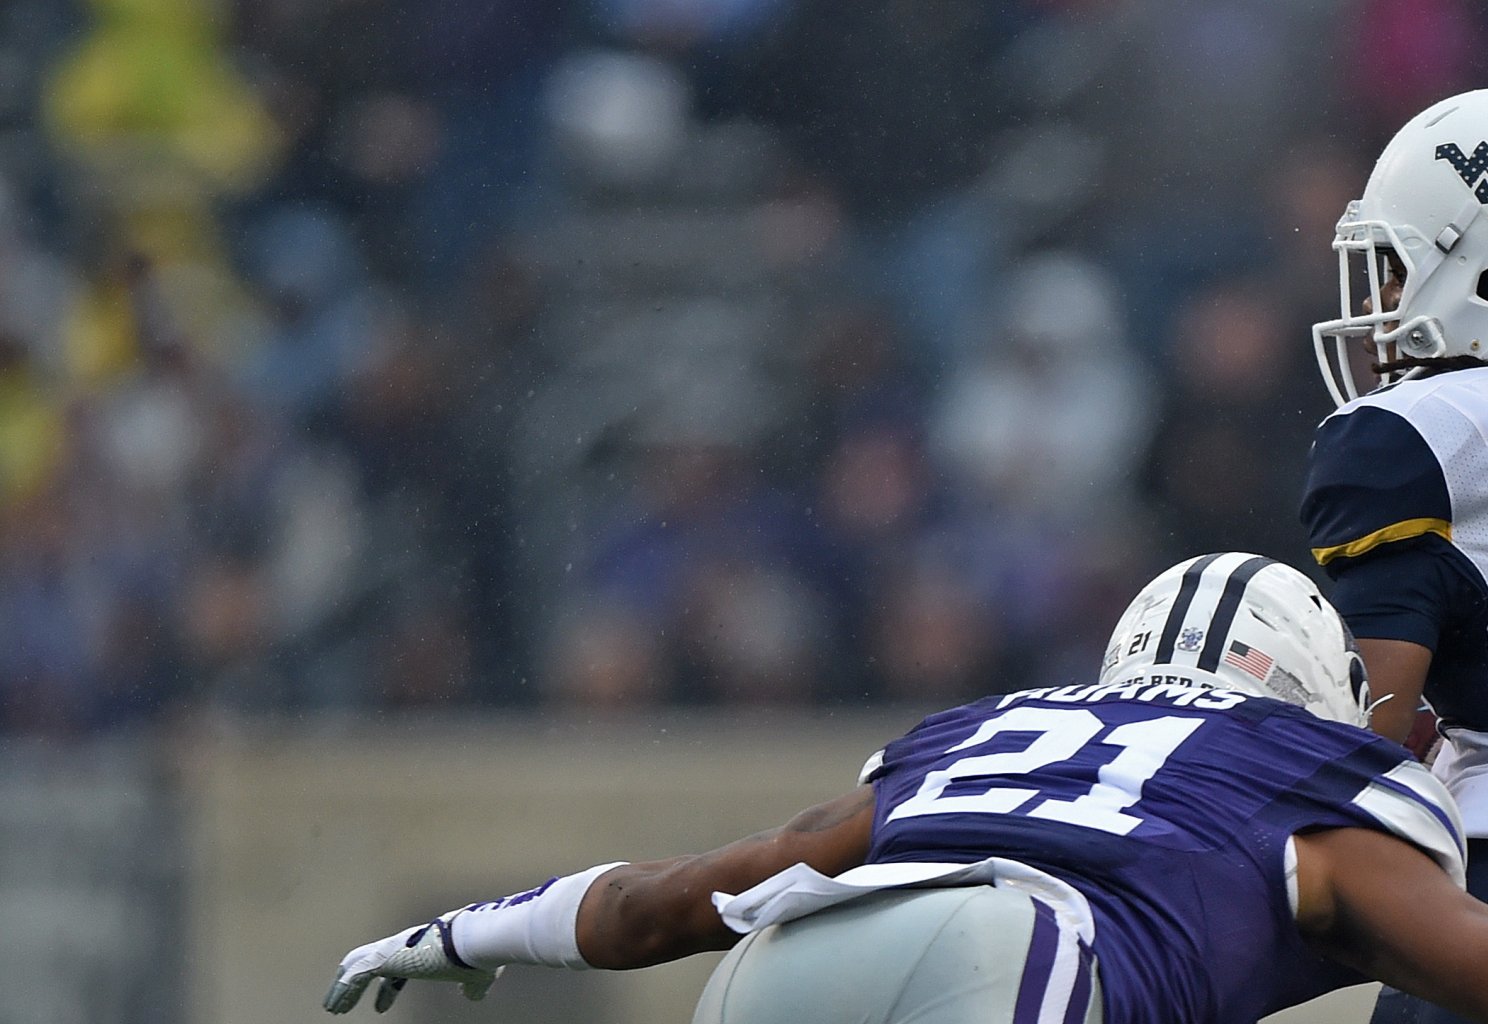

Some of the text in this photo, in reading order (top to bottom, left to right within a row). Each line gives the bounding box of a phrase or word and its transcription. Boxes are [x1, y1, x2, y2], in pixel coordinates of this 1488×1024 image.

[1127, 630, 1153, 656] 21
[995, 684, 1247, 710] ADAMS
[884, 706, 1206, 836] 21
